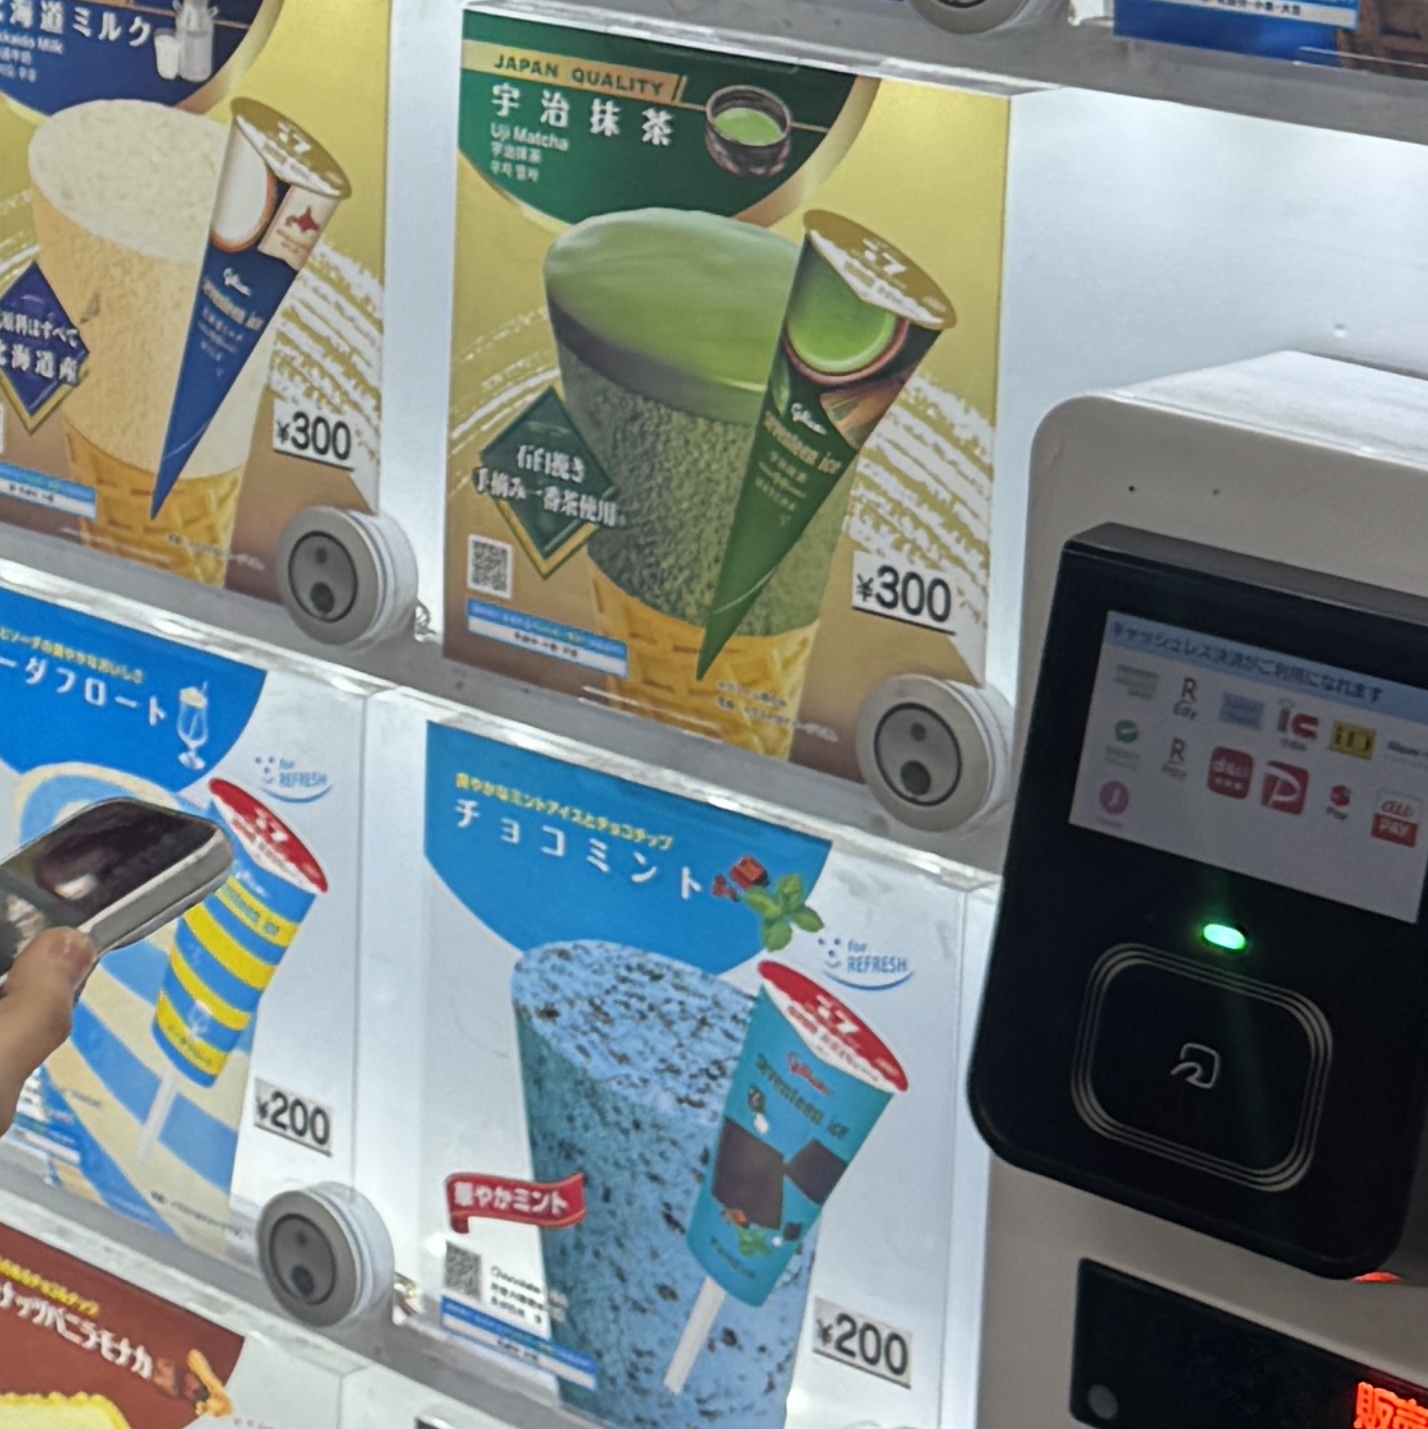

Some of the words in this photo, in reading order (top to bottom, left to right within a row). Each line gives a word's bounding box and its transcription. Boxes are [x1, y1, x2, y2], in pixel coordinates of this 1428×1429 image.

[493, 54, 559, 79] JAPAN
[572, 67, 666, 95] QUALITY
[490, 123, 511, 142] Uji
[513, 126, 569, 152] Matcha
[491, 83, 675, 146] 宇治抹茶
[276, 411, 352, 460] ¥300
[855, 564, 951, 623] ¥300
[279, 772, 328, 788] REFRESH
[454, 797, 703, 901] チョコミント
[846, 938, 868, 955] for
[846, 955, 908, 973] REFRESH
[256, 1091, 330, 1146] ¥200
[815, 1313, 909, 1375] ¥200
